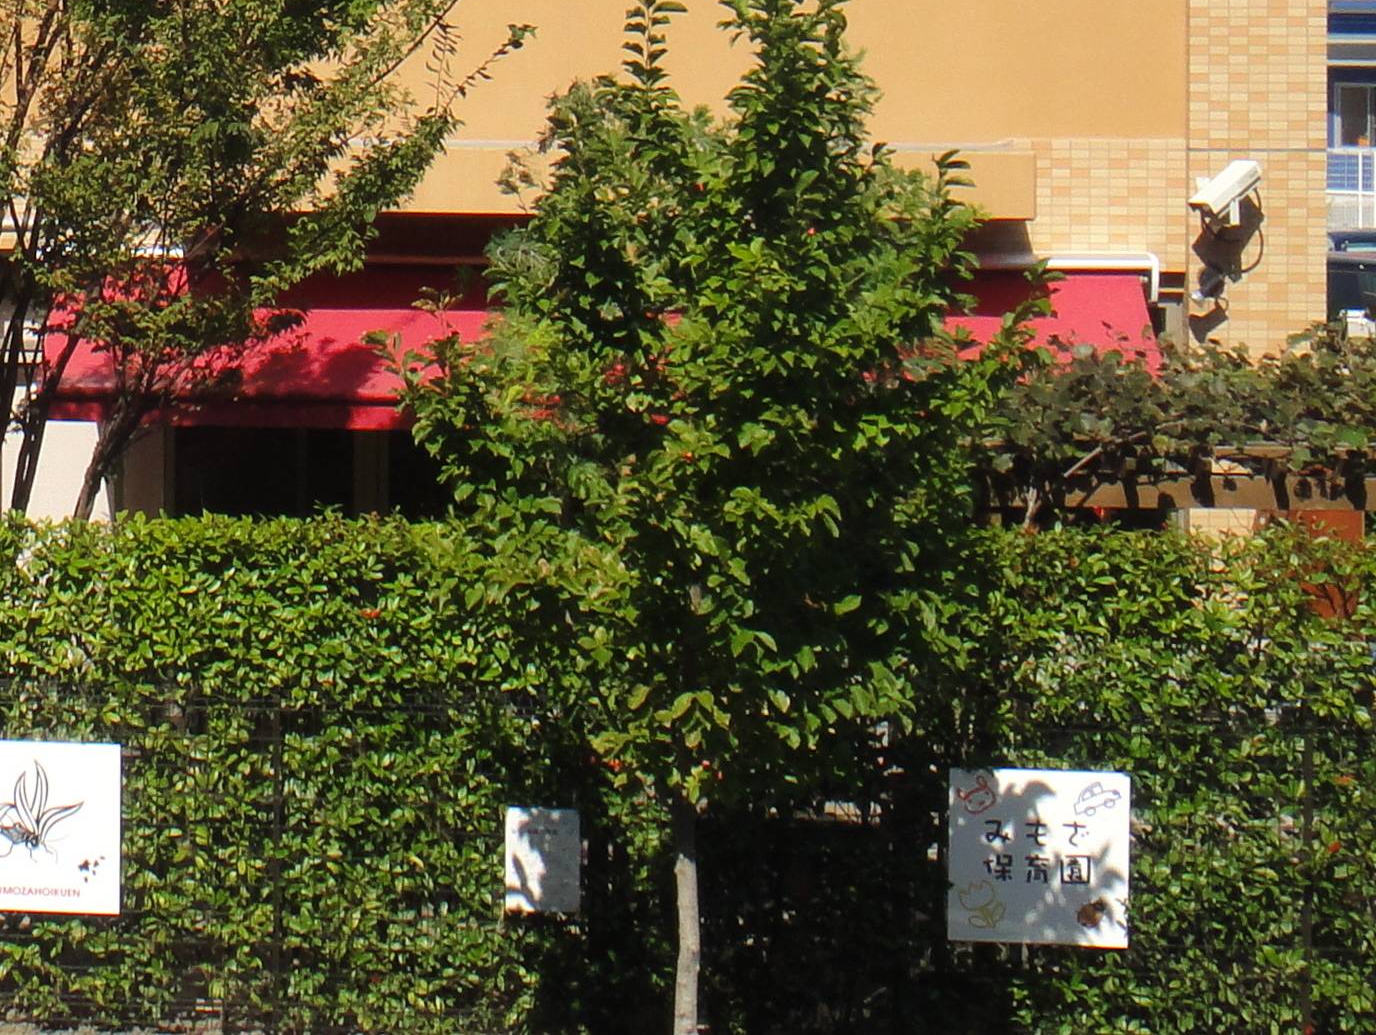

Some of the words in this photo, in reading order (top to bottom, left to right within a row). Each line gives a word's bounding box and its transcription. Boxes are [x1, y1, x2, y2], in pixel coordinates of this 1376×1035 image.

[984, 816, 1090, 847] みもざ
[983, 853, 1091, 884] 保育園
